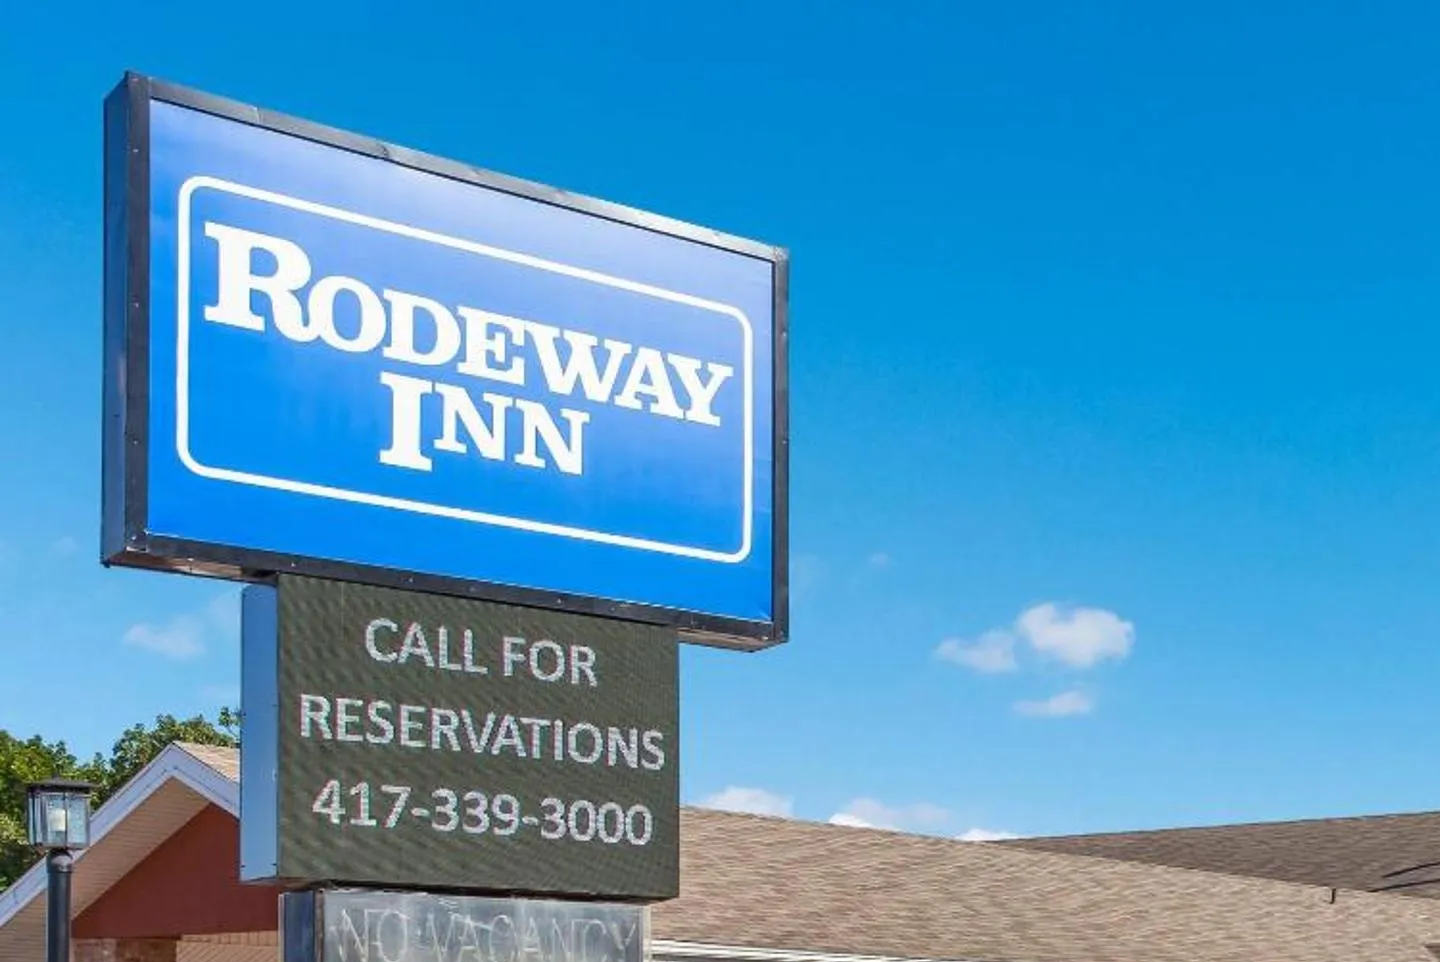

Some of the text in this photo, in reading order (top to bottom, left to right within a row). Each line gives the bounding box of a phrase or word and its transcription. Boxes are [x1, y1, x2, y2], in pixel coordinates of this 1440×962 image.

[204, 221, 733, 427] RODEWAY
[379, 371, 590, 476] INN
[364, 617, 599, 688] CALL FOR
[299, 693, 666, 771] RESERVATIONS
[311, 779, 655, 847] 417-339-3000
